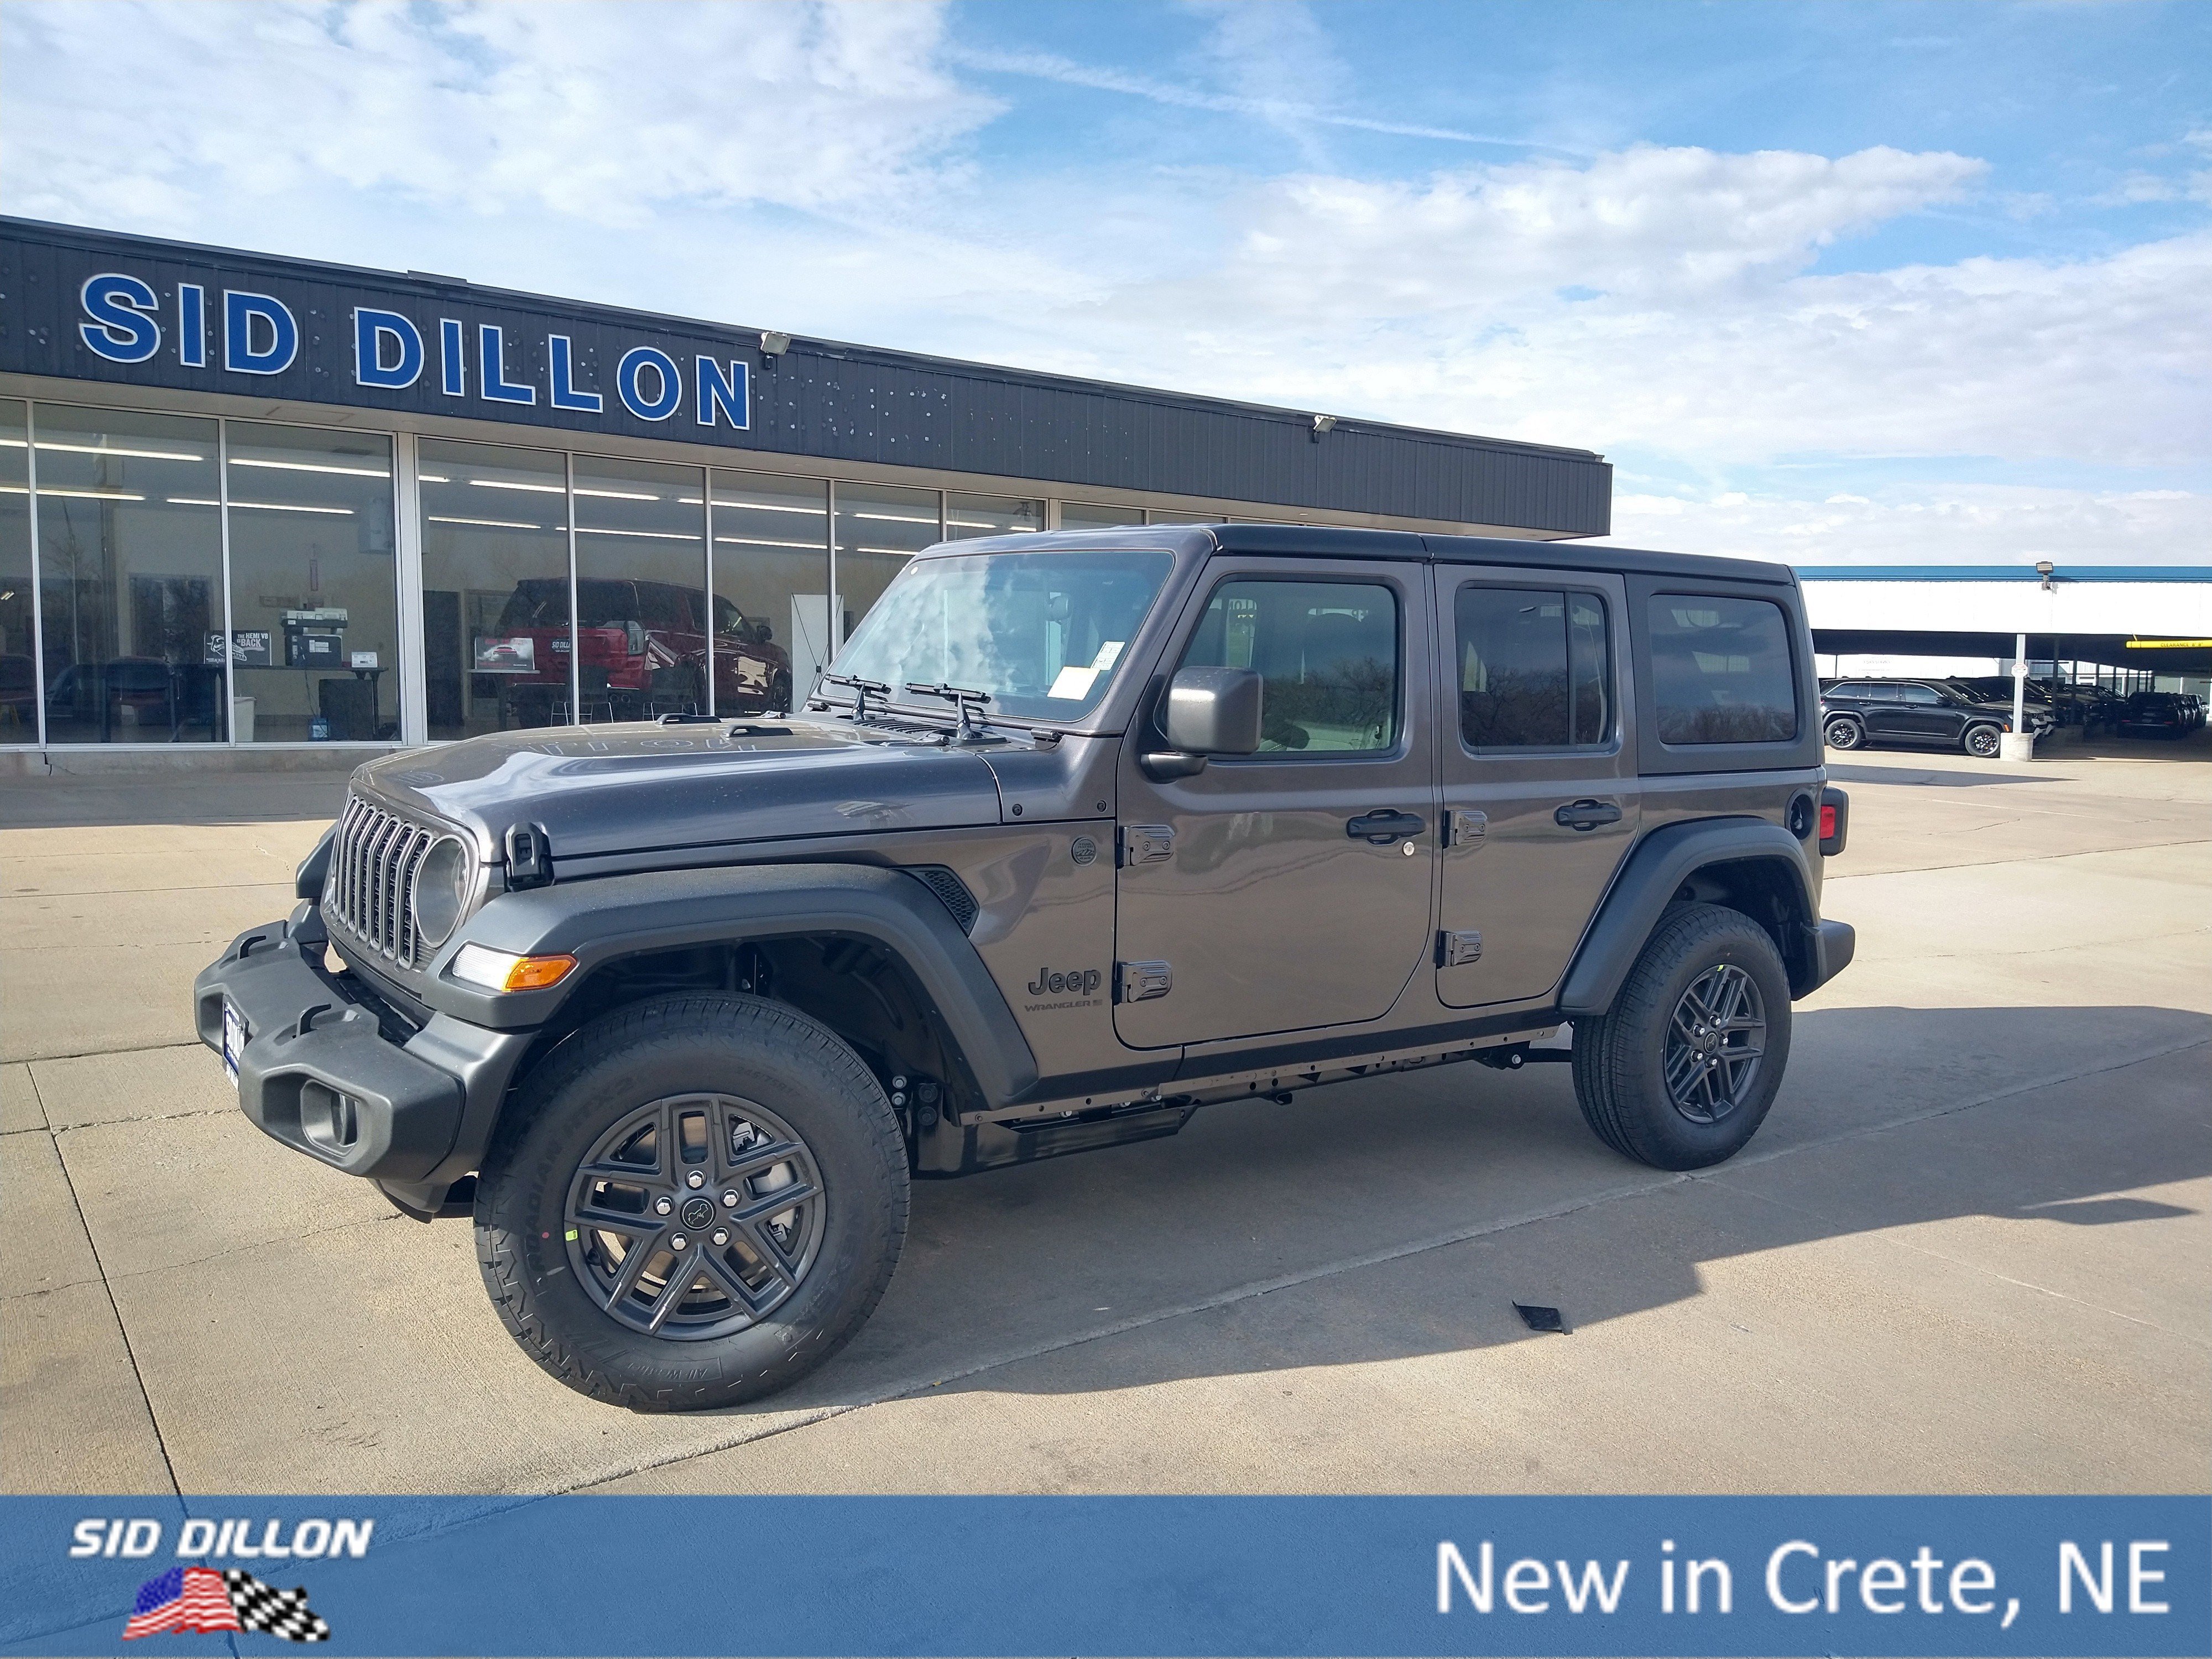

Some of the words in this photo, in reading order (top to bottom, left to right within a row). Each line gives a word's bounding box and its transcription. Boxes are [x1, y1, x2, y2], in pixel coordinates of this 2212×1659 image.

[79, 273, 299, 375] SID
[353, 306, 750, 430] DILLON
[241, 639, 262, 647] BACK
[1028, 967, 1102, 995] Jeep
[1024, 1000, 1091, 1012] WRANGLER
